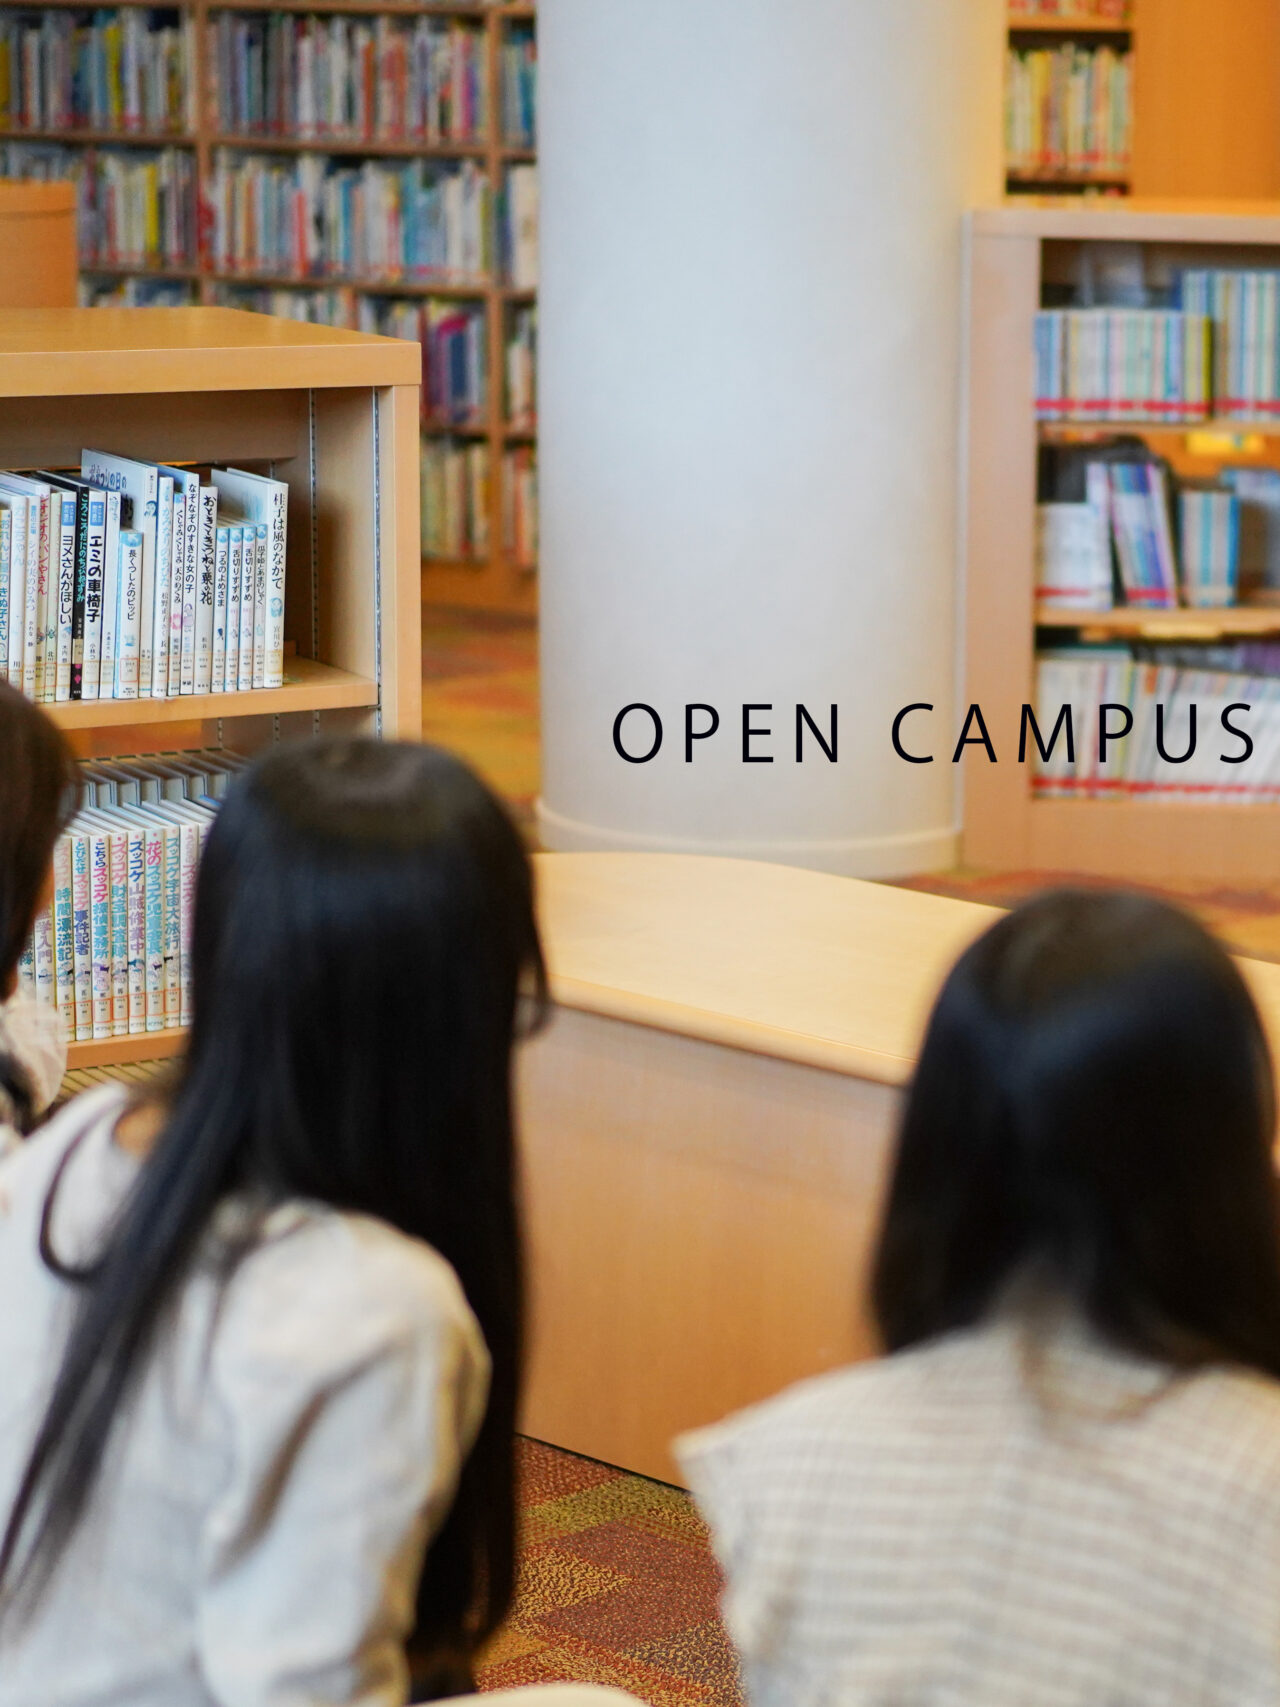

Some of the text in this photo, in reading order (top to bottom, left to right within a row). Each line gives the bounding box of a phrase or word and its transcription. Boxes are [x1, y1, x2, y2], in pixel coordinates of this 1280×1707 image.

[60, 535, 74, 624] ヨメさんがほしい
[86, 535, 103, 623] エミの車椅子
[165, 837, 181, 950] ズッコケ宇宙大旅行
